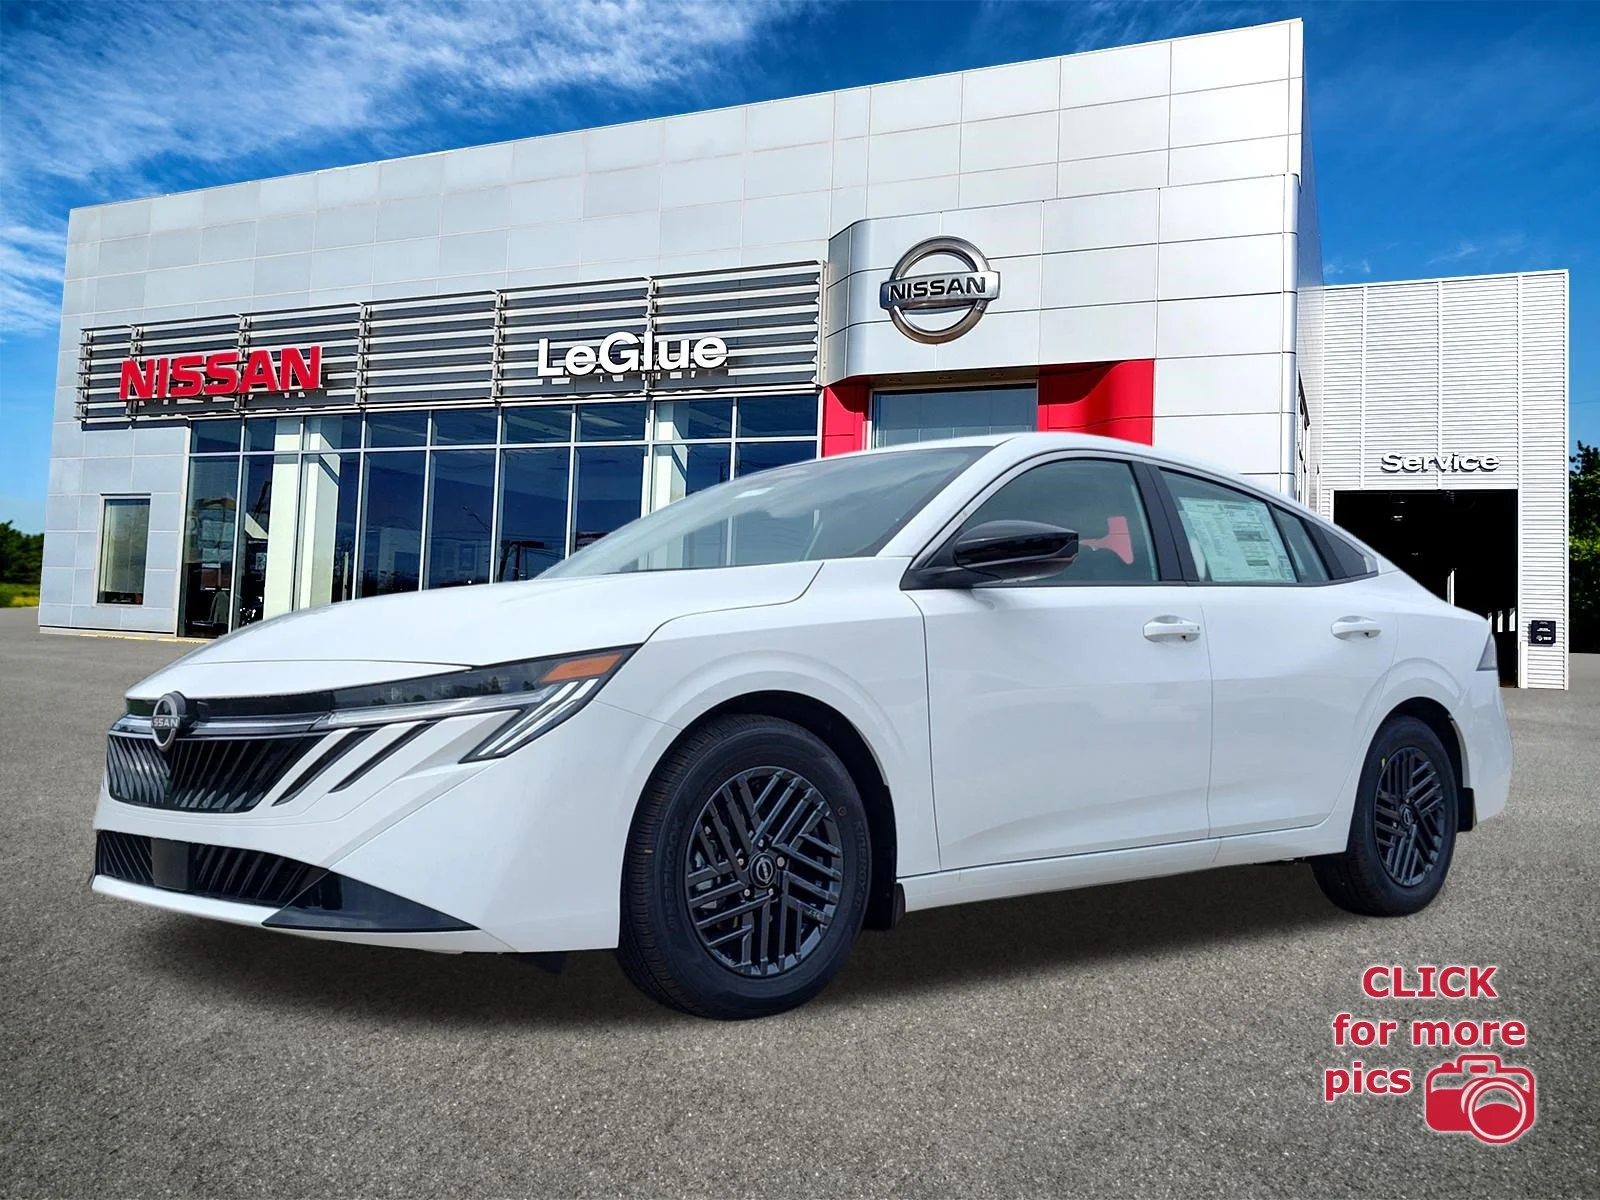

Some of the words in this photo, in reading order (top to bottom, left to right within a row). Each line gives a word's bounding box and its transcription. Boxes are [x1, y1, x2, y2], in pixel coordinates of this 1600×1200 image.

[888, 277, 986, 301] NISSAN
[537, 331, 728, 377] LeGlue
[119, 345, 323, 400] NISSAN
[1381, 451, 1501, 473] Service
[152, 718, 178, 728] SSAN
